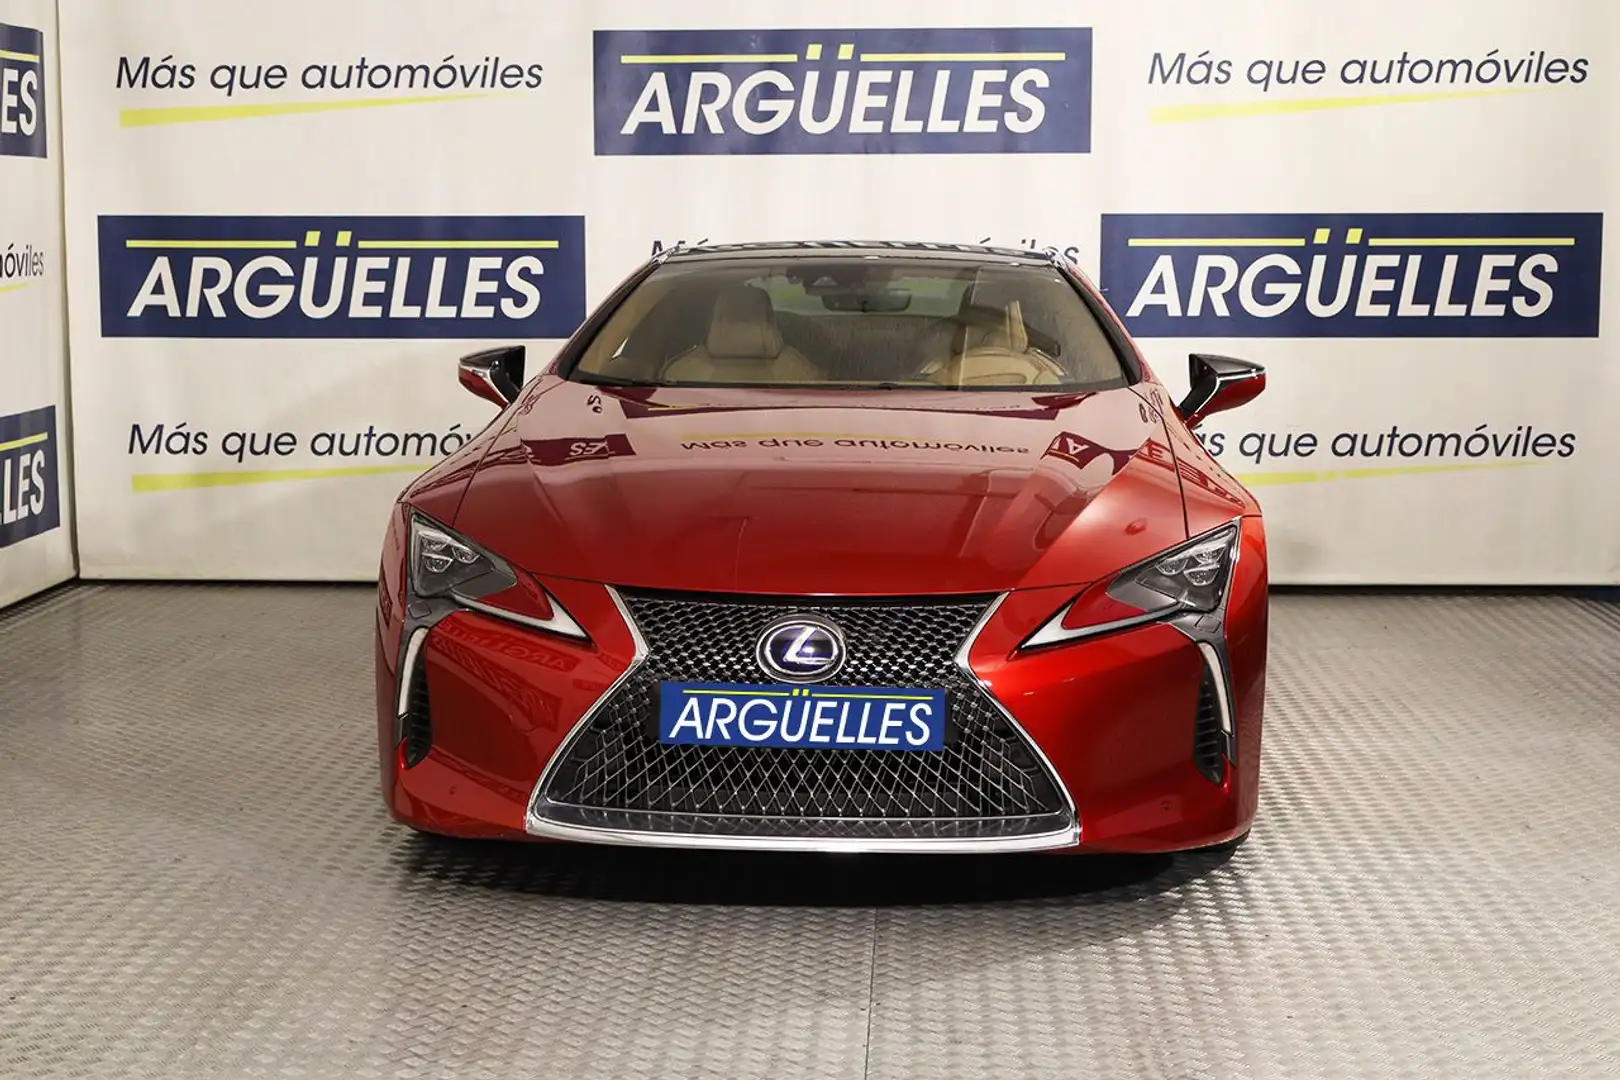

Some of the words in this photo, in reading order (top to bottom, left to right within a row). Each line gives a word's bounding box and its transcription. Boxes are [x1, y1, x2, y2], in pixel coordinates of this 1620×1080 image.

[116, 54, 196, 90] Más
[210, 65, 288, 95] que
[301, 54, 544, 90] automóviles
[620, 43, 1050, 136] ARGÜELLES
[1148, 50, 1232, 86] Más
[1246, 59, 1326, 93] que
[1340, 49, 1589, 85] automóviles
[126, 230, 545, 319] ARGÜELLES
[1125, 227, 1560, 318] ARGÜELLES
[128, 421, 208, 456] Más
[221, 431, 298, 463] que
[1239, 432, 1318, 464] que
[1330, 424, 1577, 458] automóviles
[668, 688, 934, 746] ARGÜELLES
